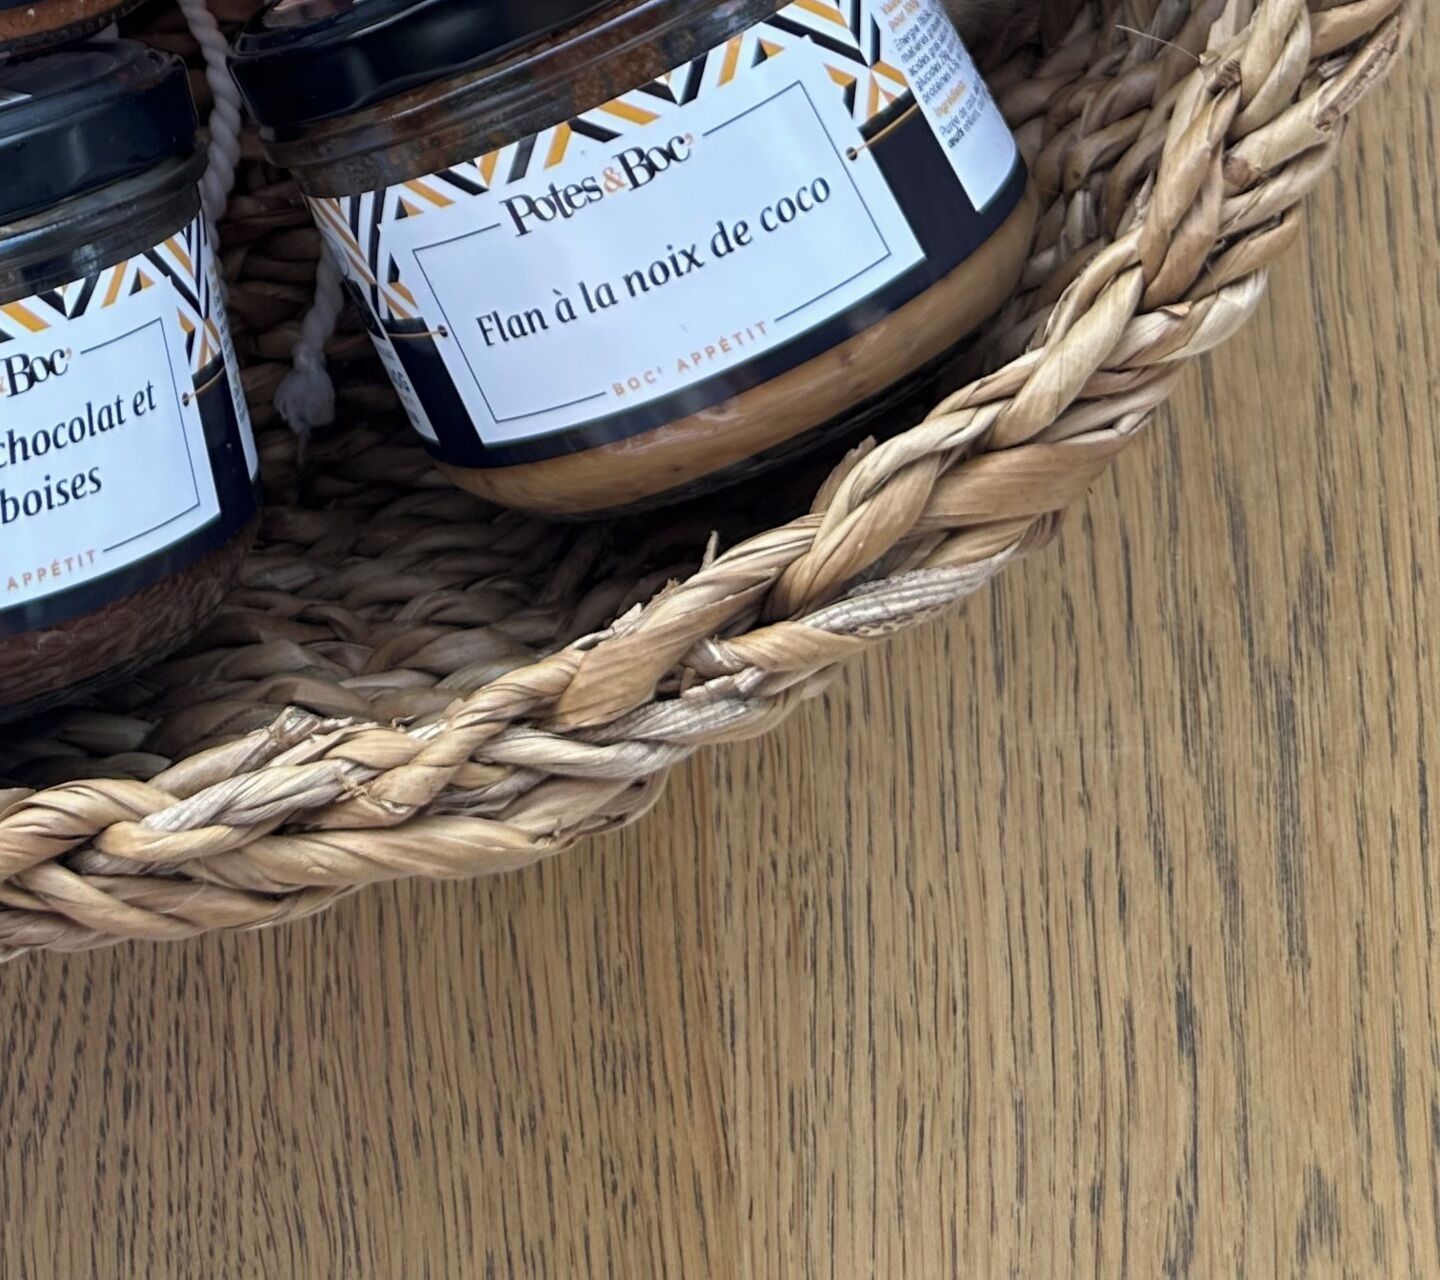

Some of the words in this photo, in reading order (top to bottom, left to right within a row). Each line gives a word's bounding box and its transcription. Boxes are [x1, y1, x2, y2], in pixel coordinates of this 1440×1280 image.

[476, 307, 548, 347] Flan
[554, 289, 577, 324] à
[583, 274, 618, 312] la
[622, 242, 706, 299] noix
[711, 206, 753, 257] de
[758, 173, 832, 234] coco
[676, 320, 769, 375] APPÉTIT
[131, 379, 158, 415] et
[8, 550, 96, 592] APPÉTIT
